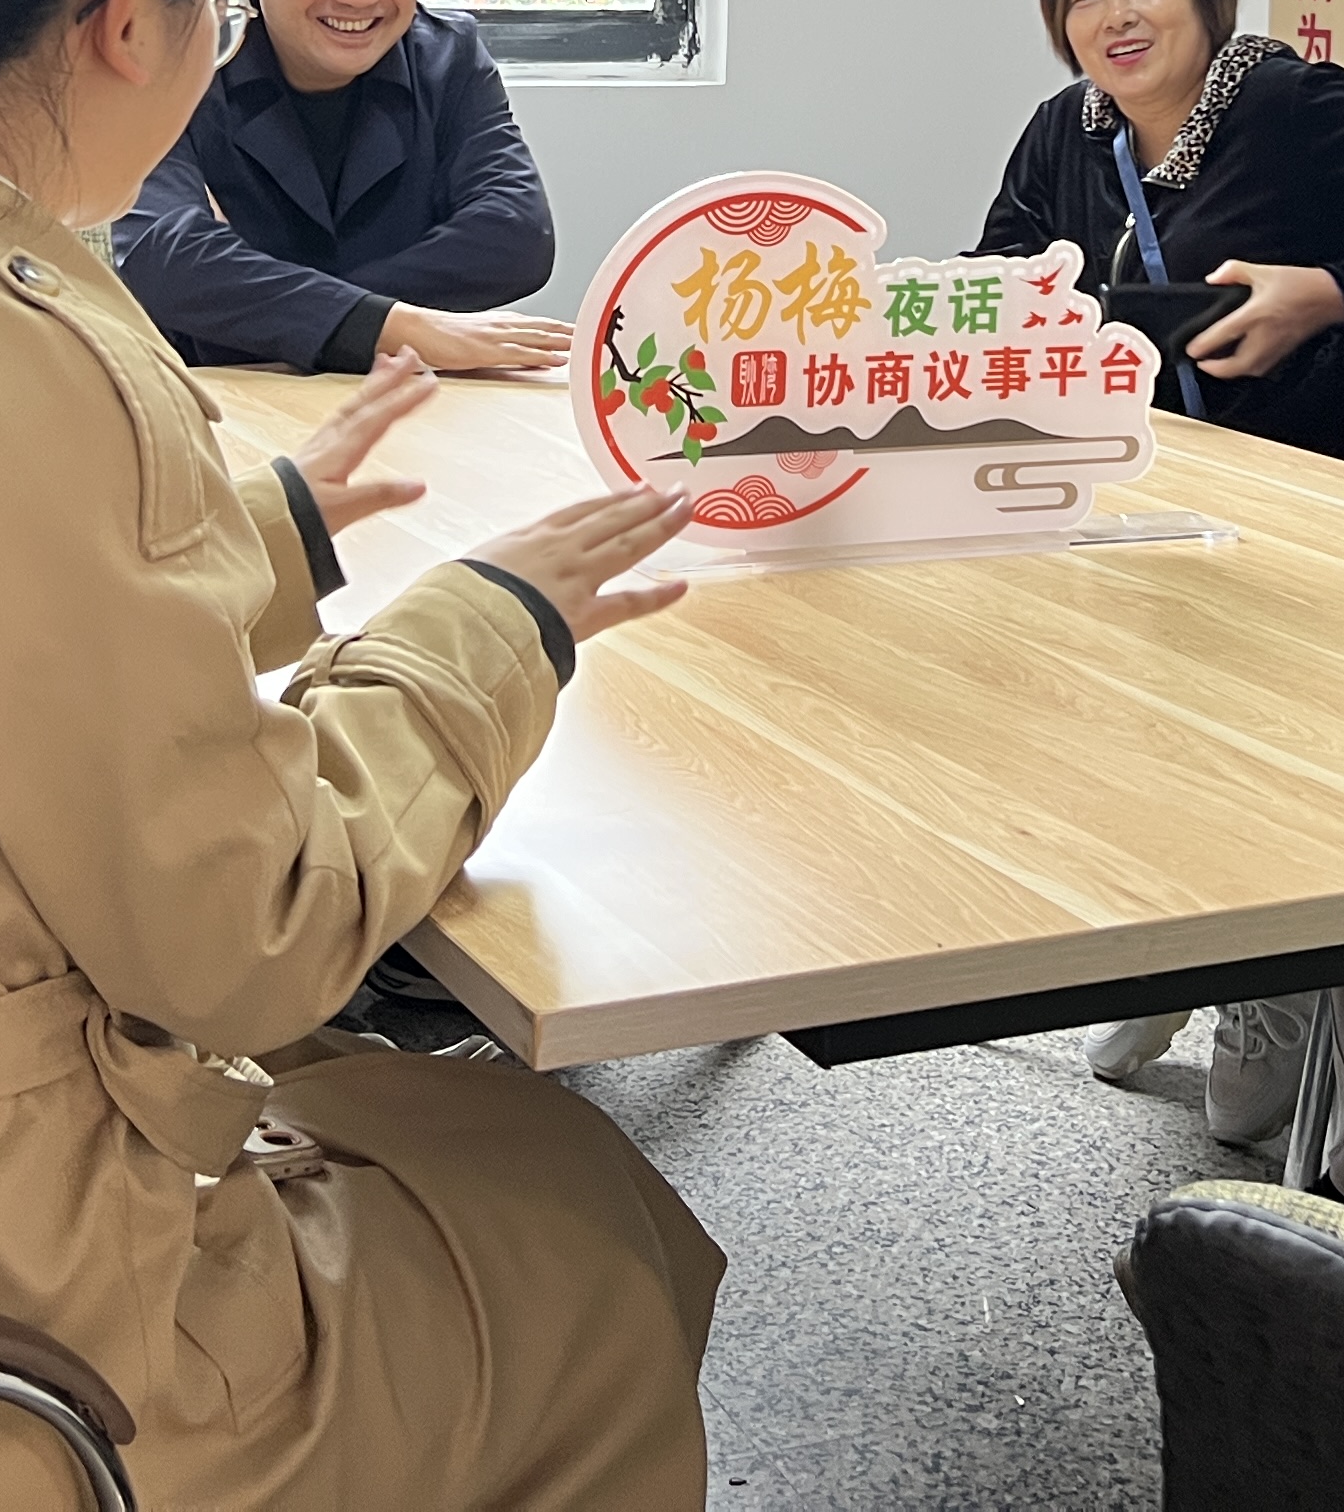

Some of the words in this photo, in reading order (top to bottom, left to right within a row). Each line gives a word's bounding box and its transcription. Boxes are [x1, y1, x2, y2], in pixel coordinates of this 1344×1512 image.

[802, 341, 1144, 410] 协商议事平台
